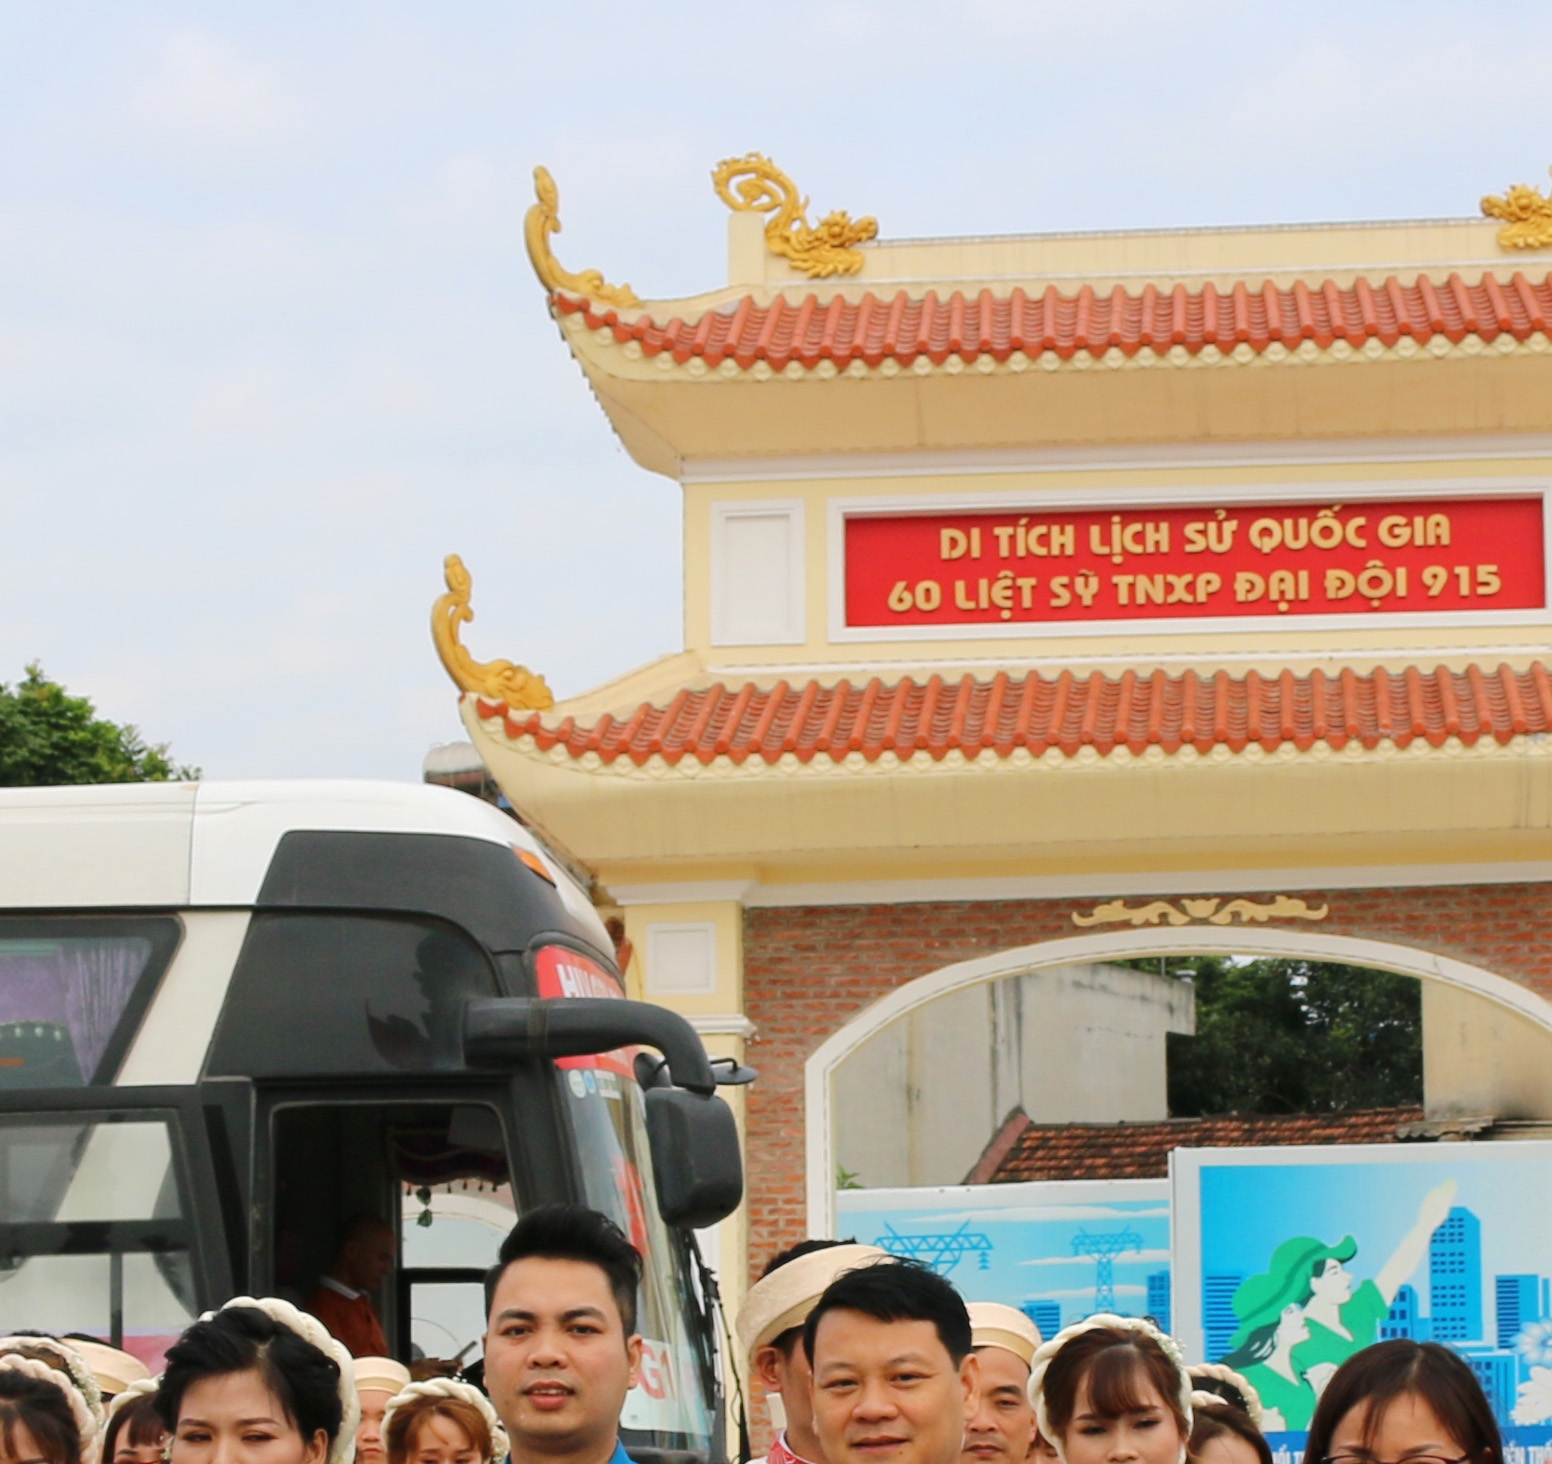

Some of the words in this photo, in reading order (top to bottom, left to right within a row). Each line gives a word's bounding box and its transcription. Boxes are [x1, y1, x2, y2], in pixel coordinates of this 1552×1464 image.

[940, 527, 981, 560] DI
[993, 517, 1075, 558] TÍCH
[1089, 515, 1170, 564] LỊCH
[1183, 509, 1239, 554] SỬ
[1249, 504, 1367, 554] QUỐC
[1377, 513, 1451, 548] GIA
[887, 580, 942, 612] 60
[954, 570, 1037, 620] LIỆT
[1049, 568, 1099, 608] SỸ
[1111, 571, 1222, 606] TNXP
[1234, 569, 1310, 612] ĐẠI
[1324, 559, 1408, 608] ĐỘI
[1421, 564, 1503, 597] 915
